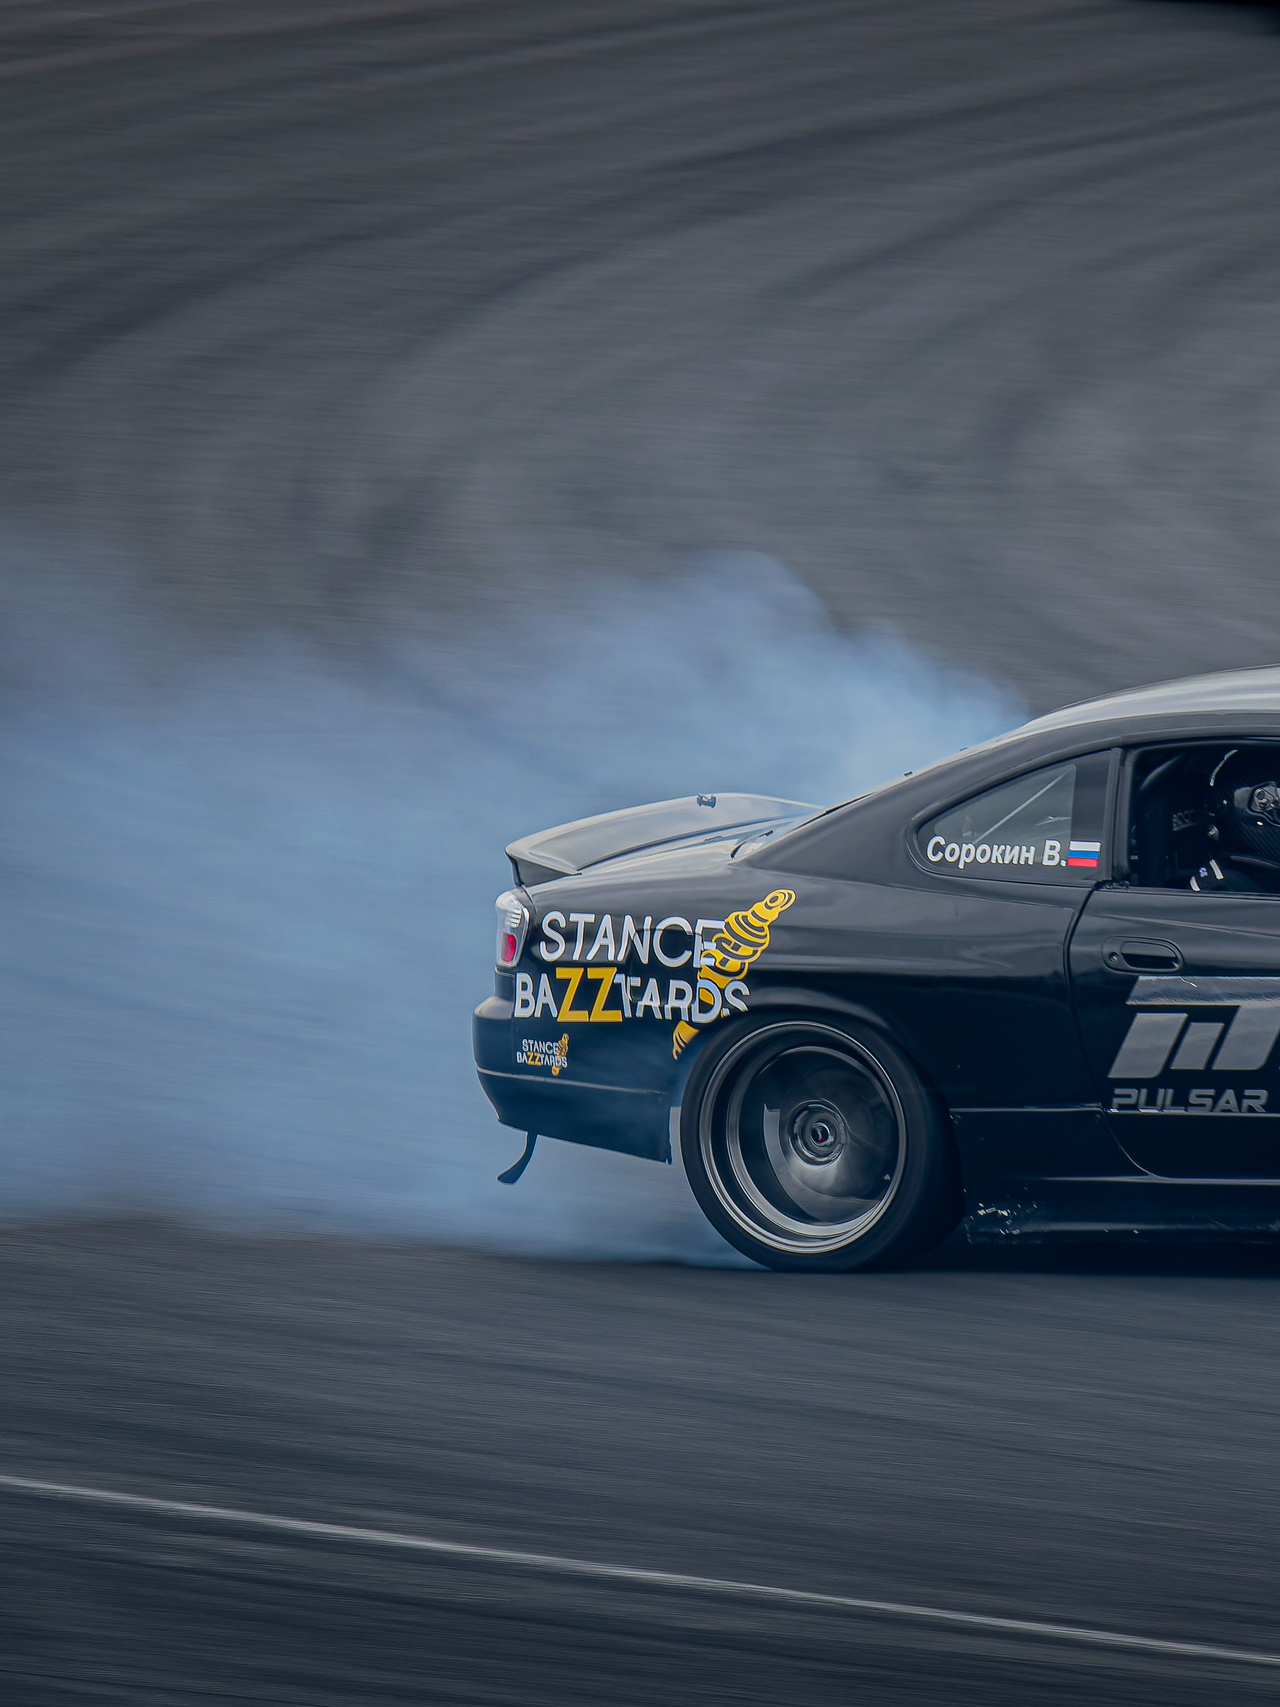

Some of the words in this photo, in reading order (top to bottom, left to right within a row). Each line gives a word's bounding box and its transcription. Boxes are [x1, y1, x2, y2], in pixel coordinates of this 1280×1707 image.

[927, 835, 1035, 869] Сорокин
[1041, 839, 1067, 867] В.
[539, 910, 726, 969] STANCE
[514, 966, 751, 1024] BAZZTARDS
[516, 1051, 568, 1068] BAZZTARDS
[522, 1038, 560, 1055] STANCE
[1111, 1087, 1268, 1114] PULSAR
